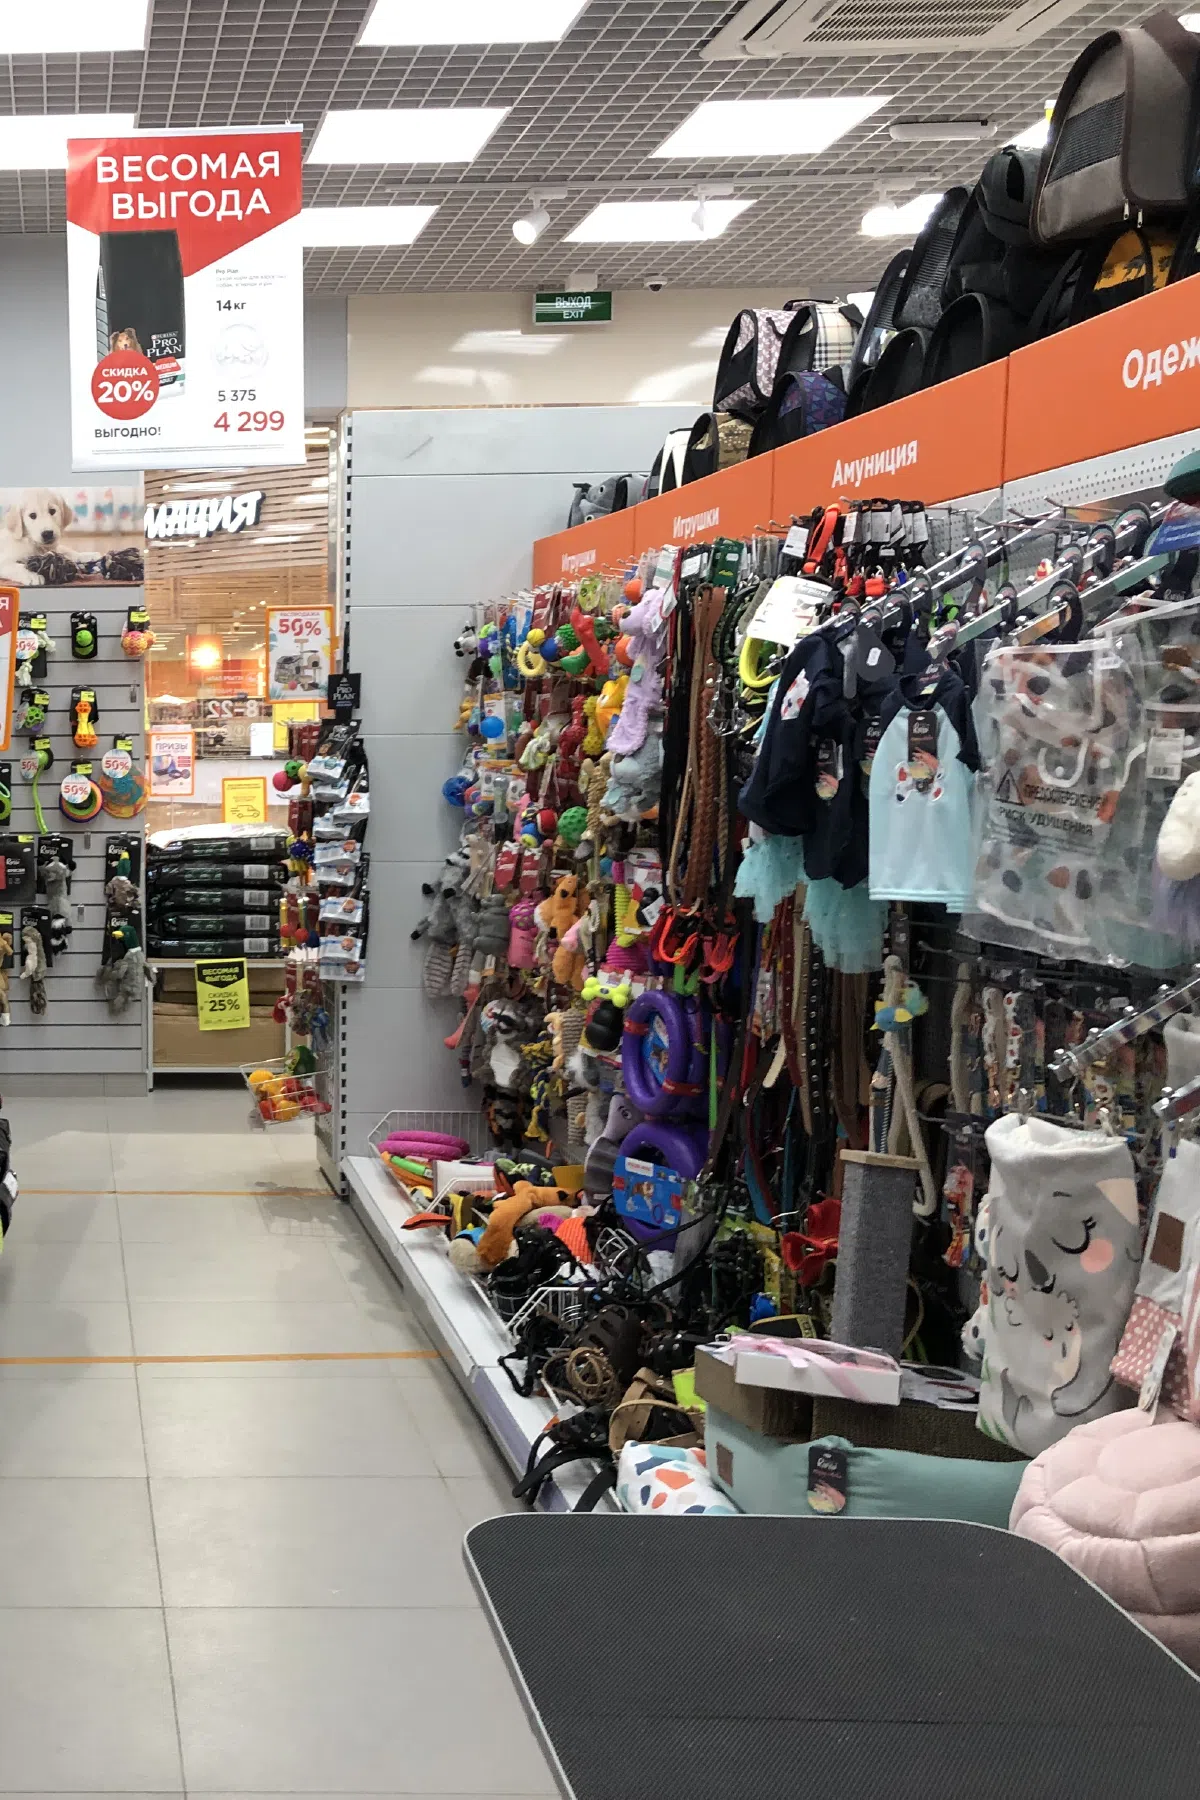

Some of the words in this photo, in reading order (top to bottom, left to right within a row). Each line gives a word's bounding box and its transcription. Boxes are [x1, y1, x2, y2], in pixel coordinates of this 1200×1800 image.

[96, 151, 280, 183] ВЕСОМАЯ
[112, 188, 271, 222] ВЫГОДА
[216, 300, 232, 311] 14
[234, 302, 246, 310] кг
[556, 296, 591, 309] ВЫХОД
[563, 310, 585, 319] EXIT
[152, 338, 178, 349] PRO
[146, 345, 182, 358] PLAN
[102, 367, 148, 378] СКИДКА
[98, 380, 154, 403] 20%
[218, 390, 226, 402] 5
[231, 389, 256, 401] 375
[213, 412, 230, 432] 4
[237, 410, 285, 432] 299
[94, 427, 161, 438] ВЫГОДНО!
[831, 440, 918, 489] Амуниция
[673, 507, 720, 539] Игрушки
[562, 549, 597, 573] Игрушки
[278, 618, 322, 636] 50%
[104, 760, 130, 771] 50%
[63, 785, 89, 795] 50%
[208, 999, 240, 1012] 25%
